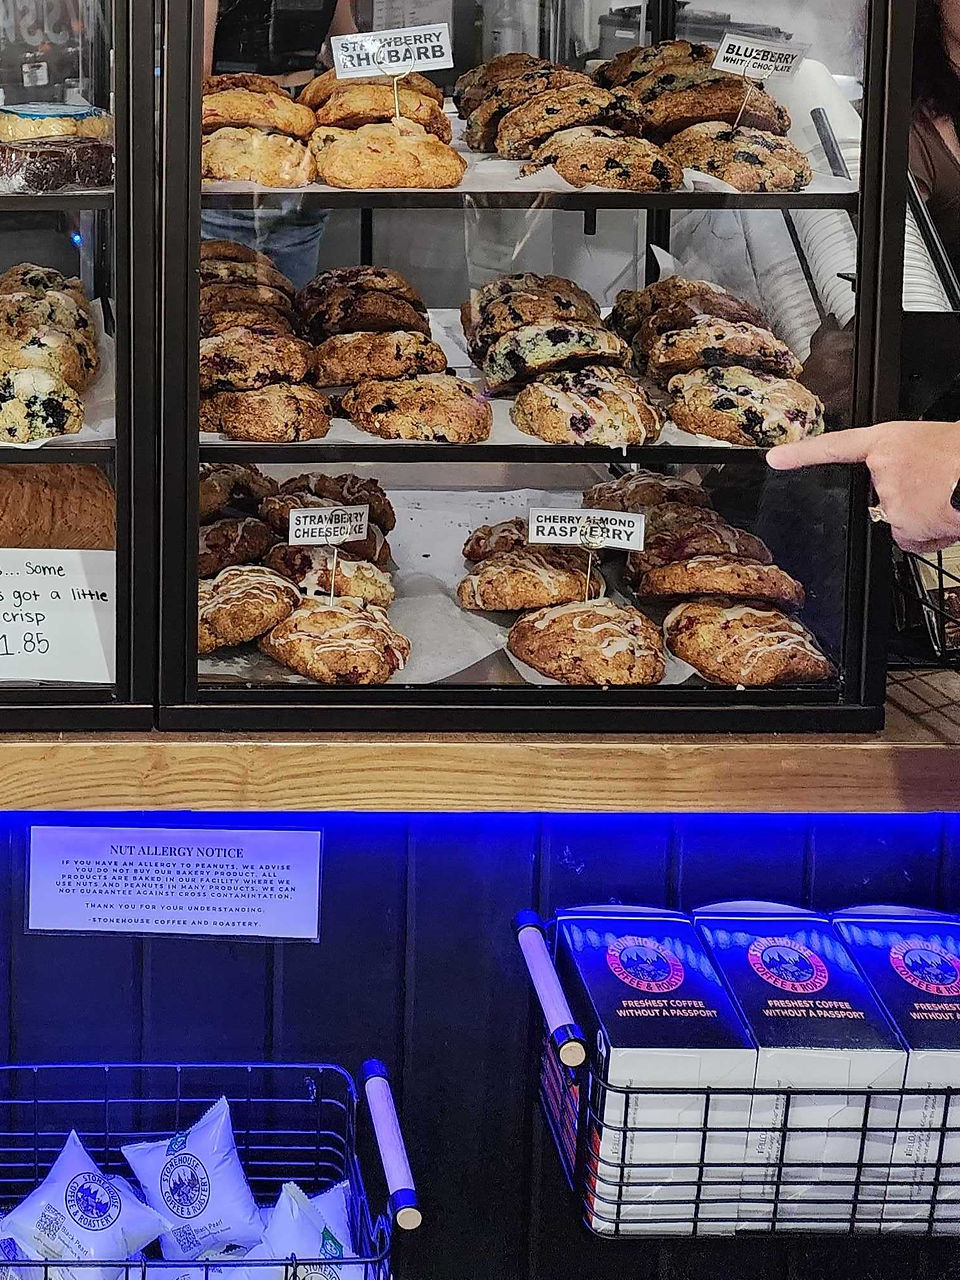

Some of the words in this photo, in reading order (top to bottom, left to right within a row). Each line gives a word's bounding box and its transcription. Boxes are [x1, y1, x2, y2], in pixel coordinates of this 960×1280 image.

[341, 45, 445, 69] RHUBARB
[725, 44, 798, 65] BLUEBERRY
[294, 512, 365, 526] STRAWBERRY
[536, 515, 582, 524] CHERRY
[12, 589, 41, 607] got
[50, 590, 62, 600] a
[71, 587, 109, 603] little
[2, 609, 46, 626] crisp
[109, 844, 136, 856] NUT
[137, 845, 194, 857] ALLERGY
[196, 847, 244, 858] NOTICE
[622, 999, 668, 1008] FRESHEST
[670, 1000, 705, 1008] COFFEE
[767, 1000, 814, 1008] FRESHEST
[815, 1001, 852, 1010] COFFEE
[616, 1009, 661, 1017] WITHOUT
[662, 1009, 670, 1017] A
[670, 1009, 718, 1018] PASSPORT
[762, 1009, 807, 1018] WITHOUT
[809, 1009, 817, 1017] A
[816, 1010, 865, 1019] PASSPORT
[162, 1155, 200, 1183] STONEHOUSE
[164, 1190, 185, 1216] COFFEE
[193, 1176, 208, 1215] ROASTERY
